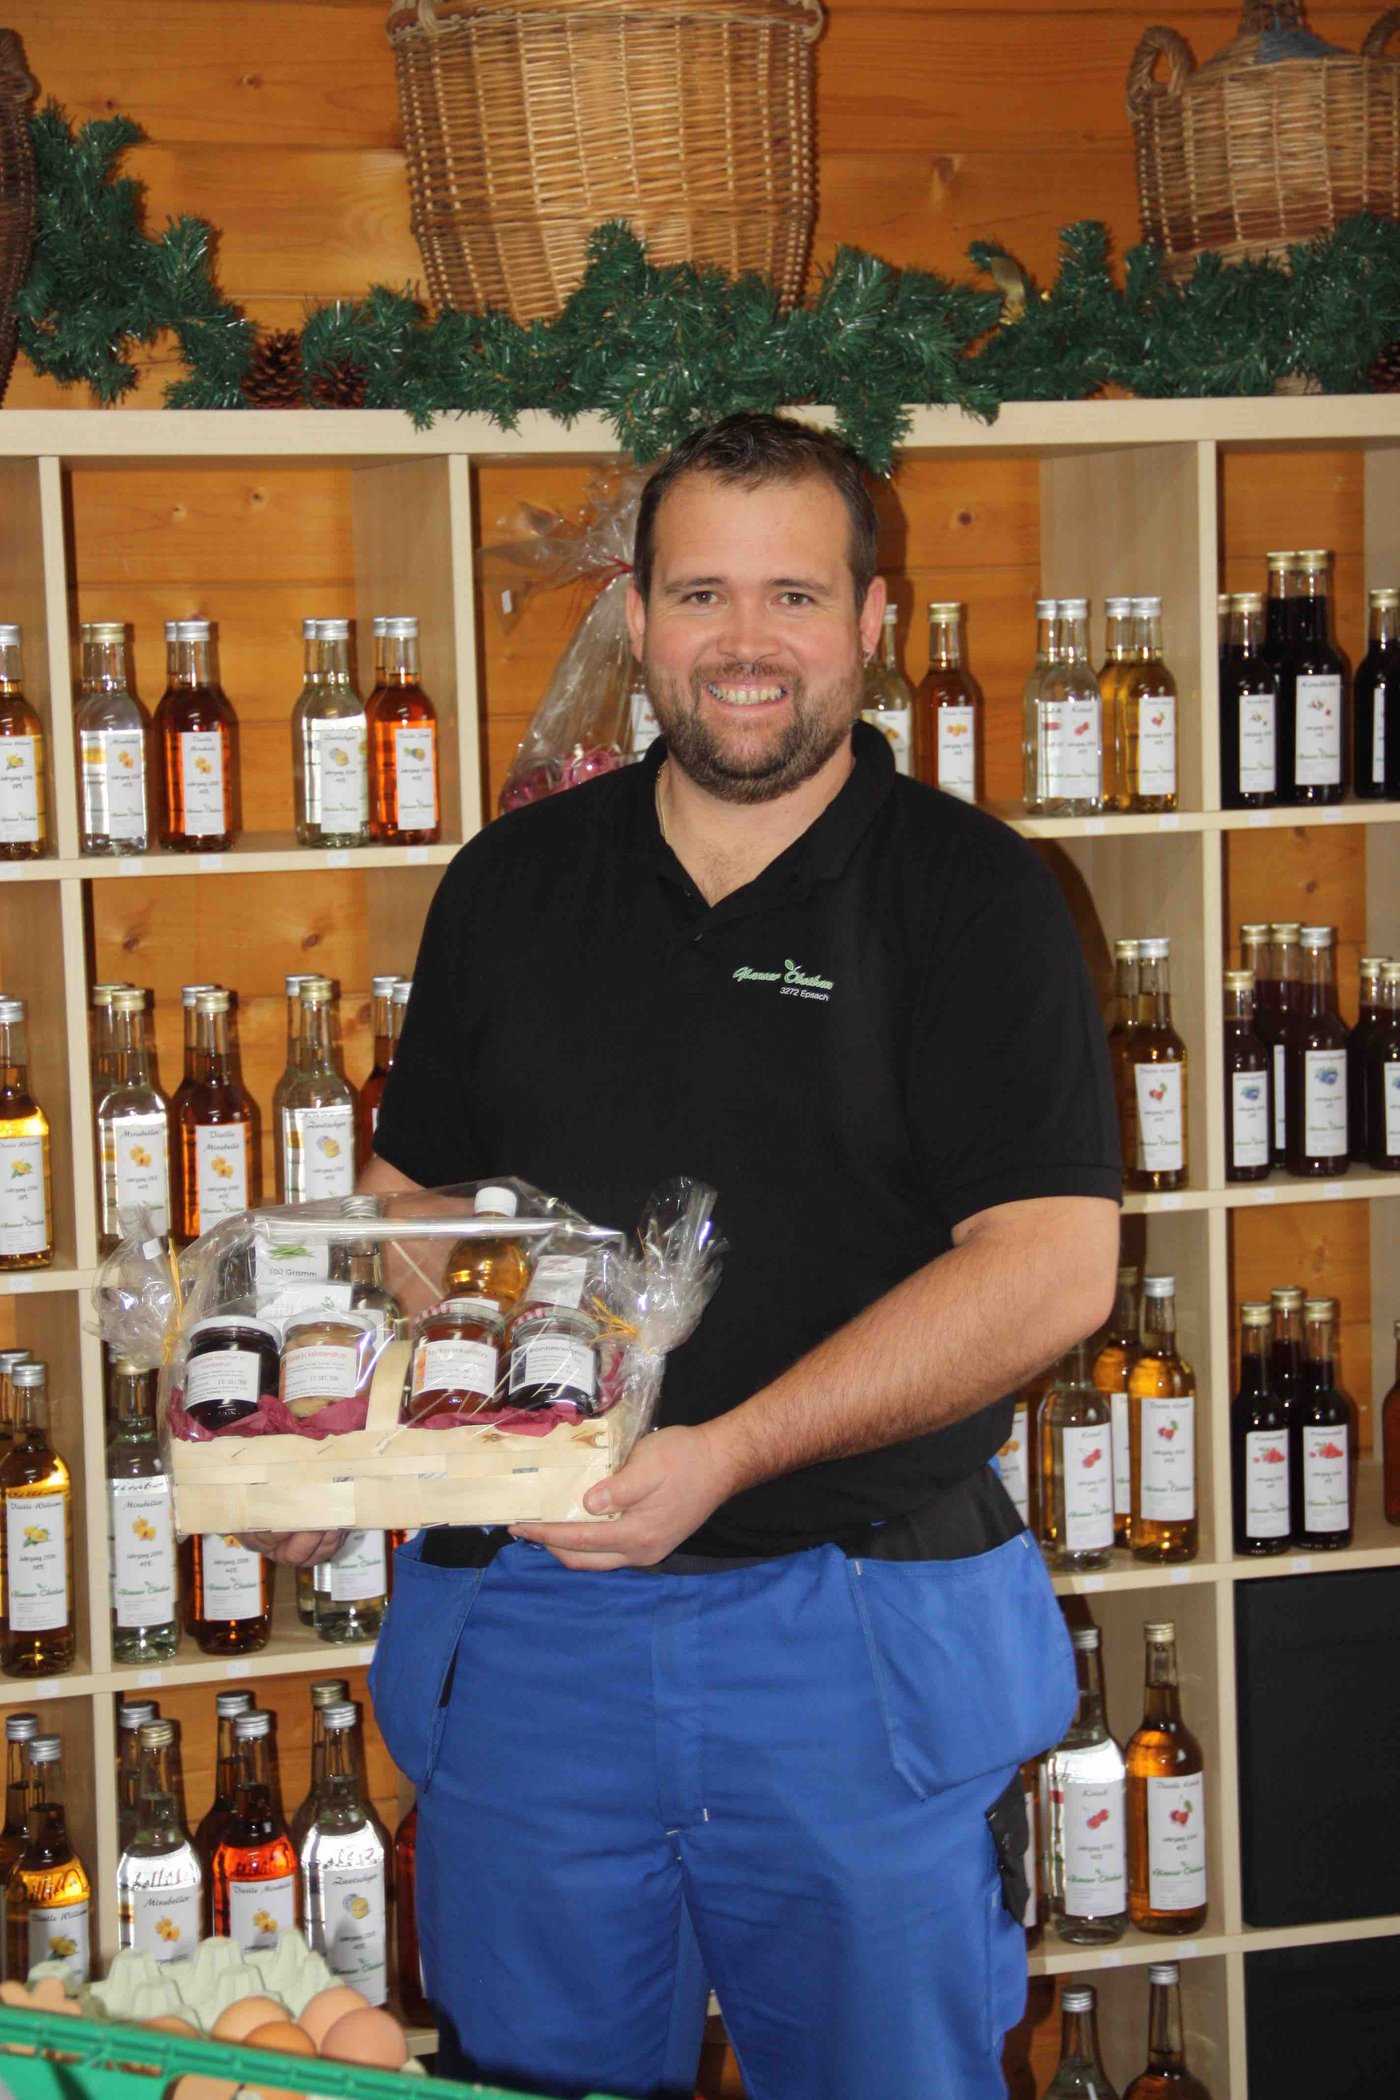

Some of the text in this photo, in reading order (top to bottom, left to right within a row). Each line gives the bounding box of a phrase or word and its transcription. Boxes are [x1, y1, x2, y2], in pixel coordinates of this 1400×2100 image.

[780, 986, 830, 1002] 3272 Epsach
[285, 1268, 318, 1278] Gramm
